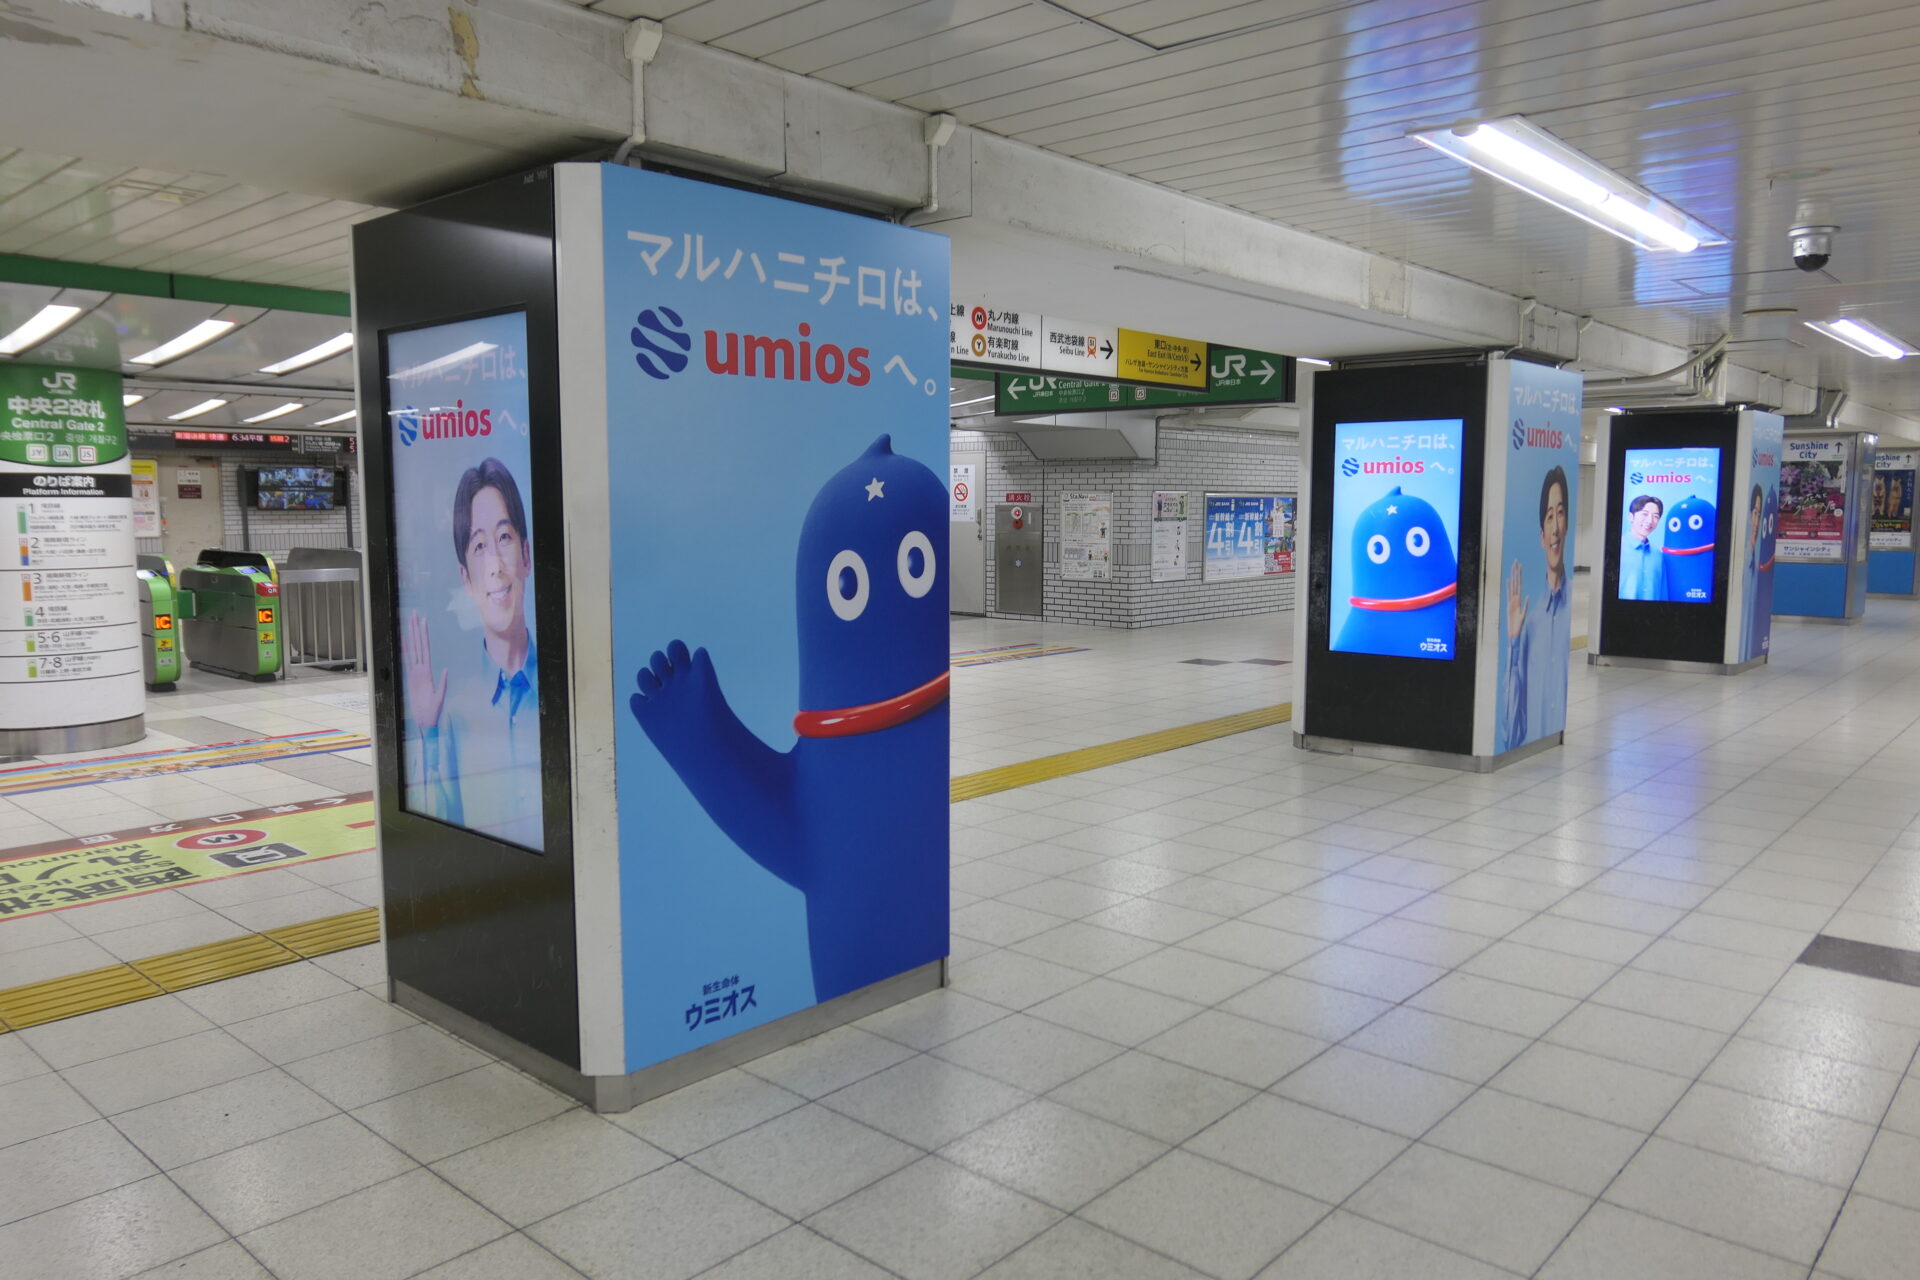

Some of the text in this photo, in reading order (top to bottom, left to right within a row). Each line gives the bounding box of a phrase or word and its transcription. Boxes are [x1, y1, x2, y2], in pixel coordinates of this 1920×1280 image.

[627, 230, 938, 321] マルハニチロは、
[988, 309, 1019, 325] 丸ノ内線
[987, 322, 1033, 337] Marunouchi Line
[988, 336, 1019, 351] 有楽町線
[1050, 332, 1085, 347] 西武池袋線
[956, 346, 969, 355] Line
[987, 349, 1030, 362] Yurakucho Line
[1059, 346, 1085, 357] Seibu Line
[704, 322, 936, 396] umios へ。
[1211, 354, 1246, 378] JR
[42, 372, 77, 390] JR
[1058, 380, 1082, 389] Central
[7, 395, 106, 419] 中央2改札
[11, 417, 105, 432] Central Gate 2
[422, 399, 492, 440] umios
[1342, 433, 1455, 451] マルハニチロは、
[1527, 421, 1563, 449] umios
[1790, 442, 1829, 451] Sunshine
[1799, 451, 1818, 459] City
[1364, 456, 1425, 474] umios
[33, 476, 96, 488] のりば案内
[1646, 472, 1692, 483] umios
[31, 537, 40, 548] 2
[33, 573, 42, 584] 3
[35, 606, 45, 617] 4
[258, 610, 273, 623] IC
[156, 616, 171, 629] IC
[1420, 642, 1448, 653] ウミオス
[80, 860, 176, 880] Seibu
[703, 975, 740, 995] 新生命体
[685, 984, 757, 1031] ウミオス
